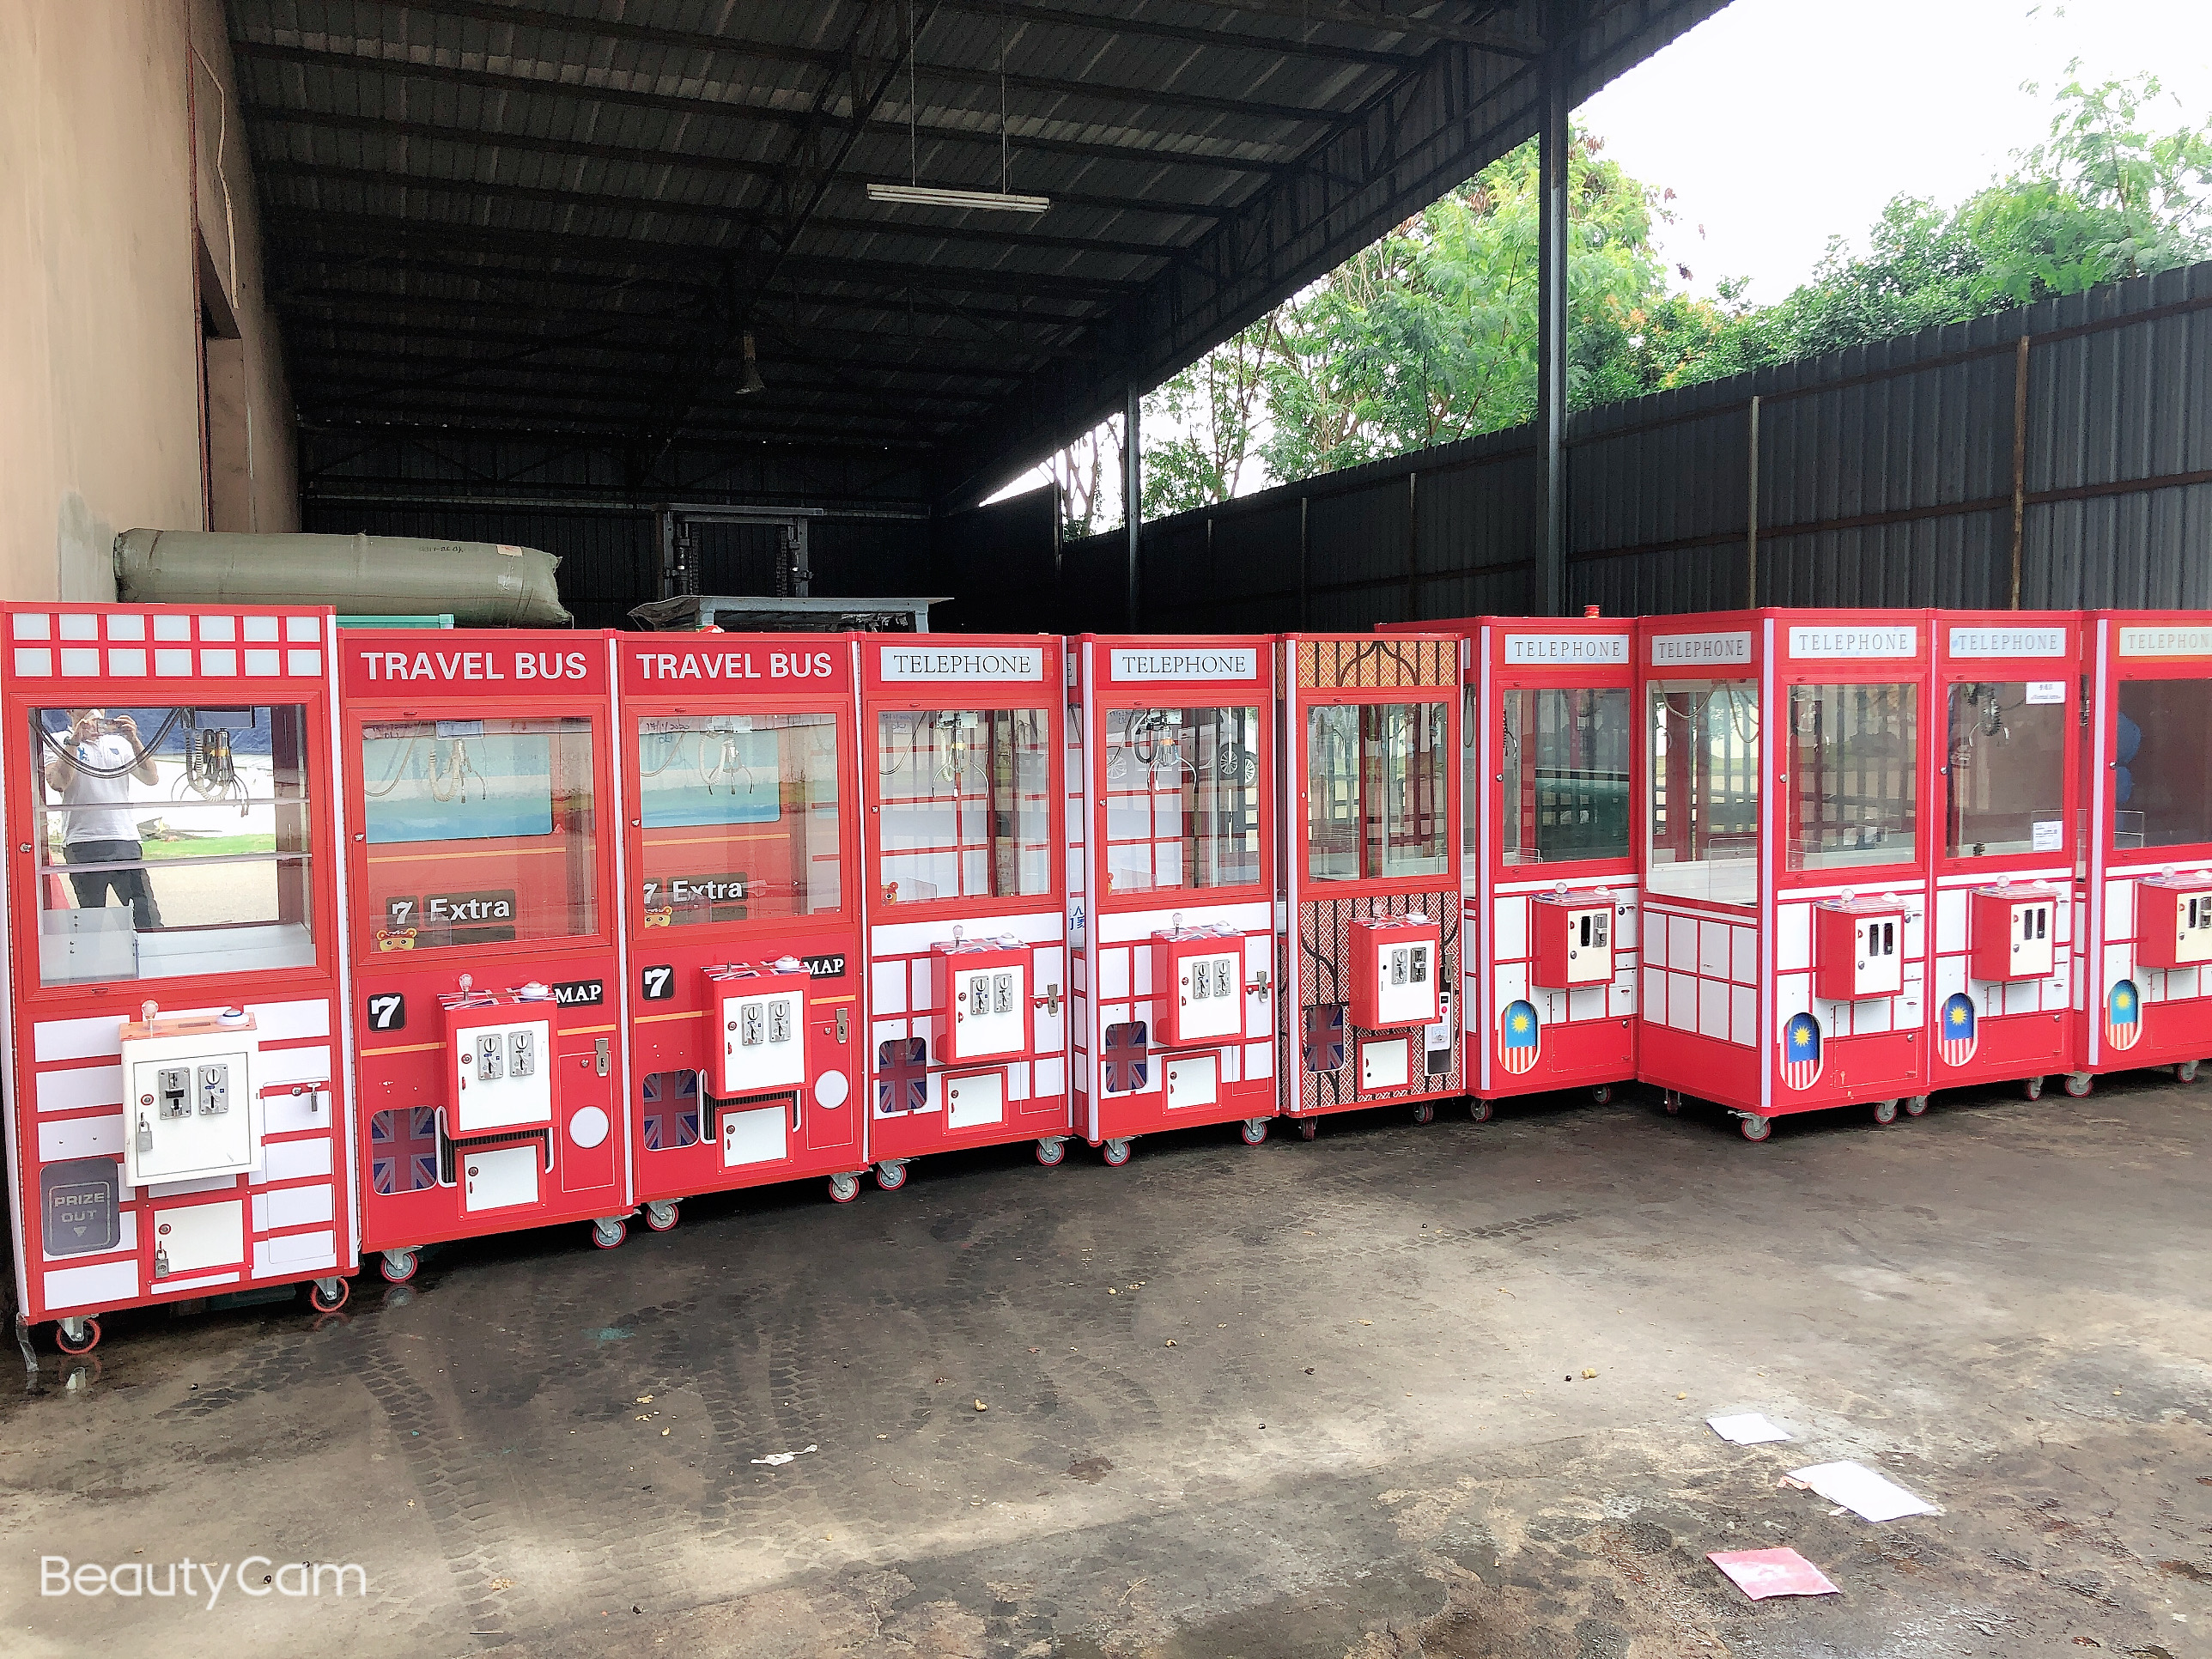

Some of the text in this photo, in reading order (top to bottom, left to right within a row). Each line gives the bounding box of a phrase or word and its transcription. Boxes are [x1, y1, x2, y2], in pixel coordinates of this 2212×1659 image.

[1514, 641, 1621, 657] TELEPHONE
[1658, 639, 1744, 659] TELEPHONE
[1799, 634, 1908, 651] TELEPHONE
[1958, 635, 2057, 650] TELEPHONE
[2128, 634, 2212, 649] TELEPHON
[360, 652, 588, 681] TRAVEL BUS
[635, 653, 833, 679] TRAVEL BUS
[893, 654, 1032, 674] TELEPHONE
[1121, 655, 1247, 674] TELEPHONE
[672, 879, 744, 903] Extra
[392, 897, 511, 926] 7 Extra
[804, 958, 845, 975] MAP
[644, 968, 672, 998] 7
[555, 984, 602, 1005] MAP
[370, 995, 401, 1029] 7
[54, 1192, 105, 1207] PRIZE
[61, 1209, 97, 1223] OUT
